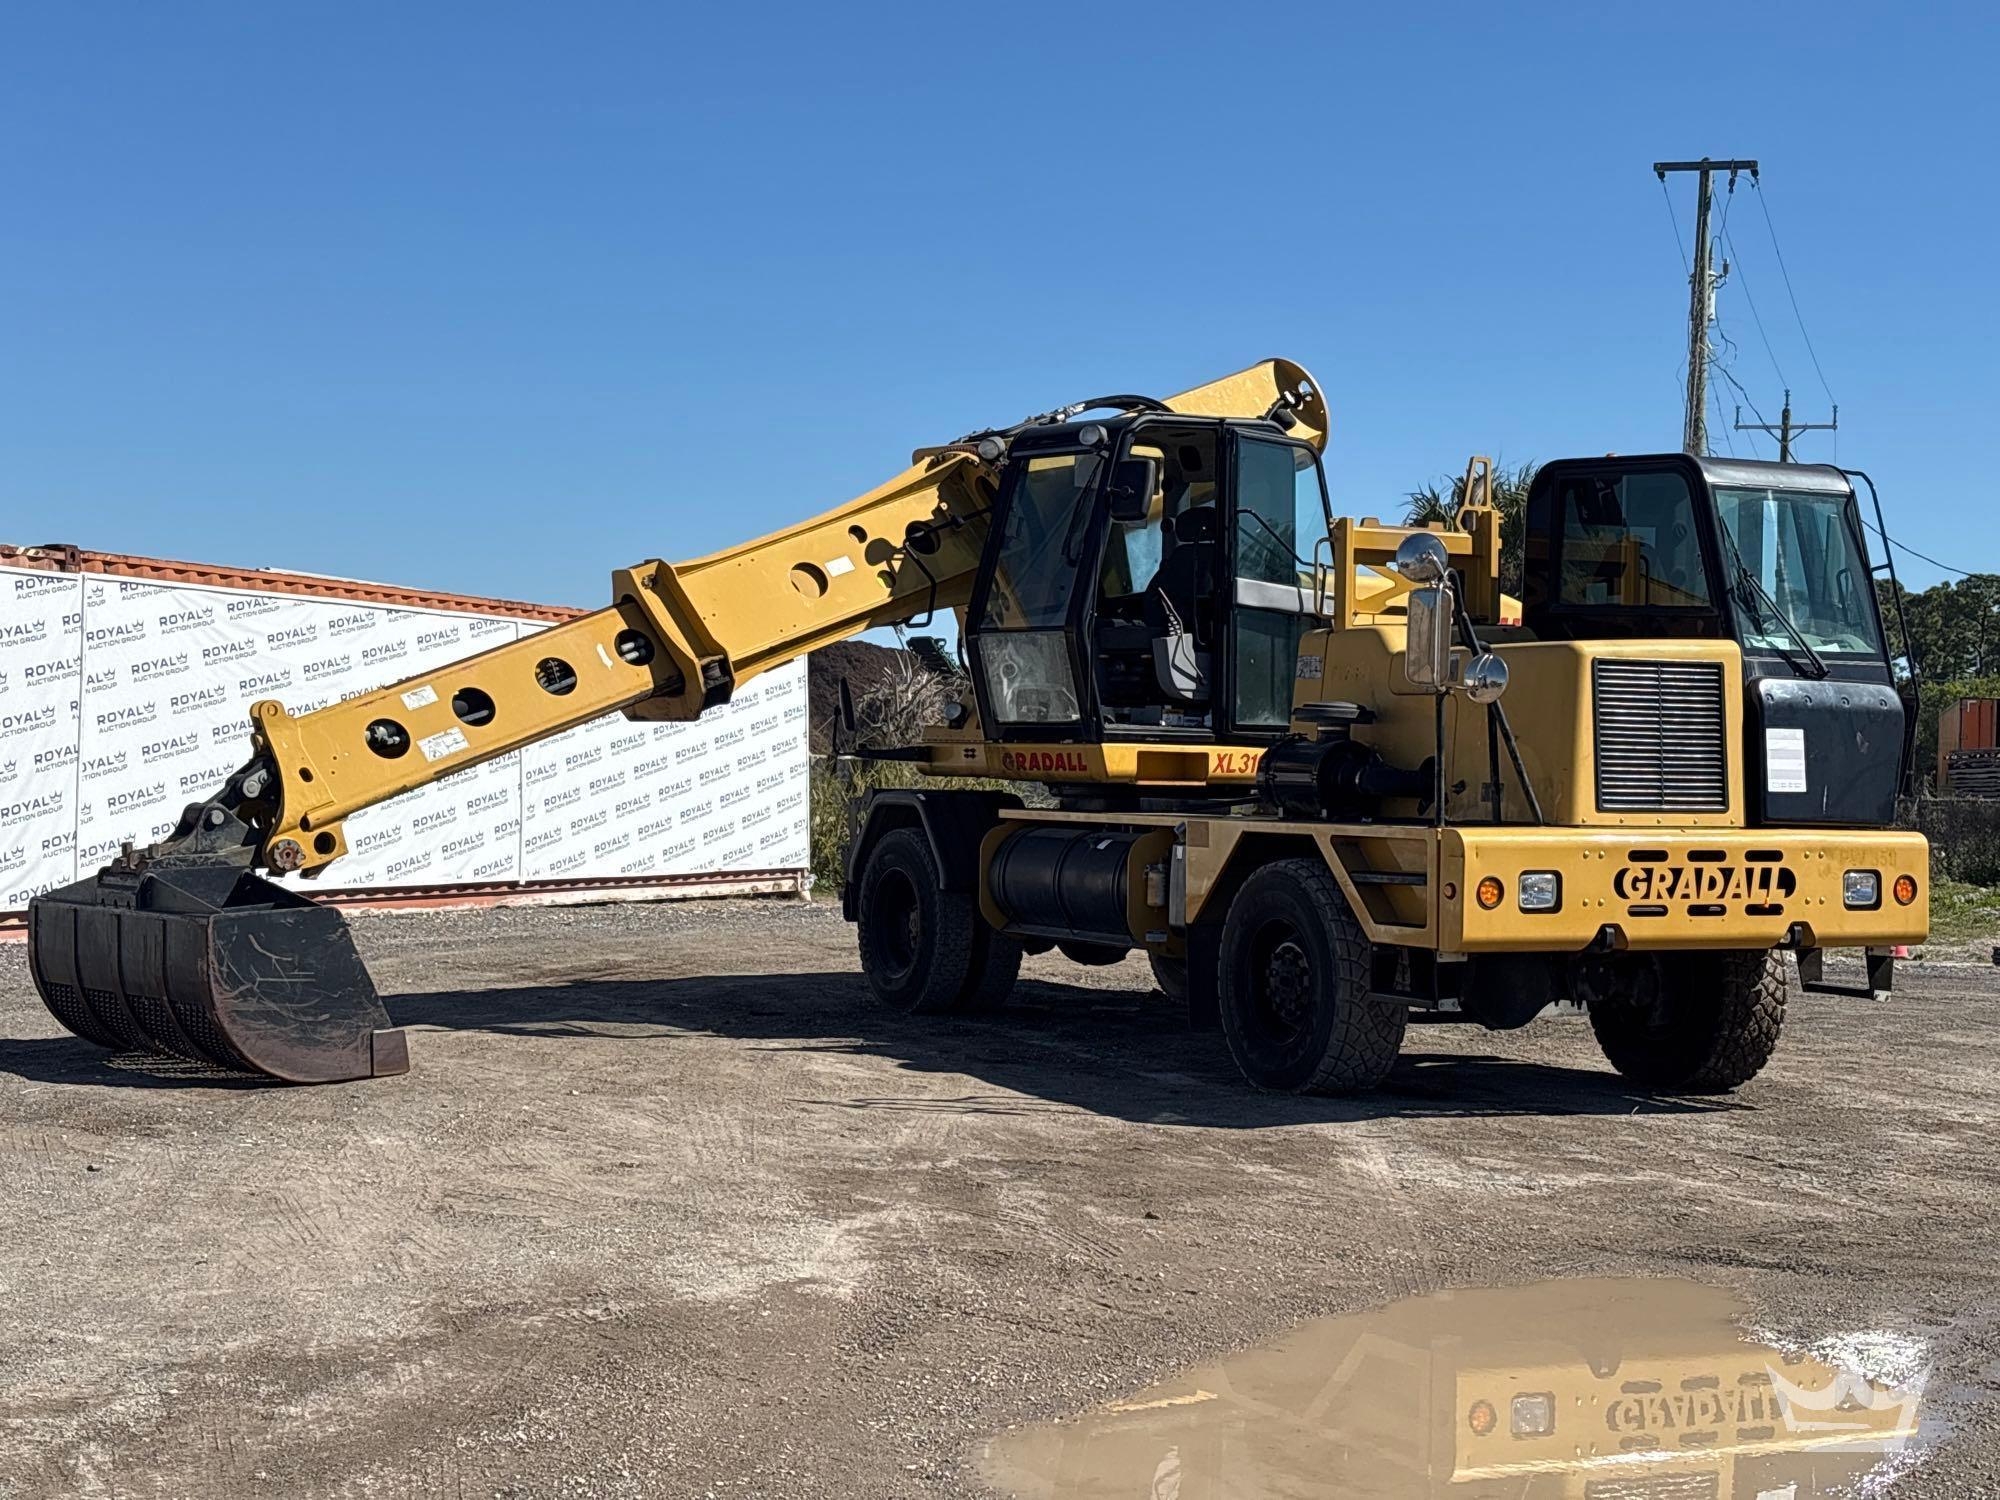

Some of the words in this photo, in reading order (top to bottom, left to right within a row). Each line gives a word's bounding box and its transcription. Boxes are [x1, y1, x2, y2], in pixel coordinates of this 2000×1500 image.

[17, 588, 50, 600] AUCTION
[52, 583, 78, 593] GROUP
[121, 590, 153, 601] AUCTION
[227, 596, 268, 613] ROYAL
[229, 611, 257, 620] AUCTION
[258, 606, 280, 614] GROUP
[159, 609, 203, 627] ROYAL
[161, 624, 191, 634] AUCTION
[192, 619, 215, 628] GROUP
[329, 613, 365, 629] ROYAL
[389, 614, 412, 622] AUCTION
[86, 623, 132, 642] ROYAL
[267, 627, 306, 644] ROYAL
[330, 627, 355, 636] AUCTION
[356, 622, 376, 631] GROUP
[417, 629, 450, 645] ROYAL
[20, 633, 47, 644] GROUP
[88, 639, 119, 650] AUCTION
[121, 633, 146, 643] GROUP
[269, 641, 295, 651] AUCTION
[297, 636, 318, 645] GROUP
[203, 641, 244, 659] ROYAL
[205, 656, 233, 666] AUCTION
[234, 650, 257, 659] GROUP
[362, 643, 397, 659] ROYAL
[363, 656, 387, 666] AUCTION
[388, 651, 407, 660] GROUP
[25, 657, 74, 679] ROYAL
[131, 656, 176, 675] ROYAL
[134, 671, 164, 682] AUCTION
[165, 666, 189, 675] GROUP
[303, 657, 341, 674] ROYAL
[305, 671, 330, 681] AUCTION
[332, 666, 352, 675] GROUP
[26, 674, 60, 687] AUCTION
[90, 683, 116, 693] GROUP
[240, 672, 280, 690] ROYAL
[242, 687, 269, 697] AUCTION
[270, 681, 292, 690] GROUP
[171, 688, 214, 707] ROYAL
[173, 703, 202, 715] AUCTION
[203, 697, 226, 707] GROUP
[730, 695, 753, 708] ROYAL
[97, 705, 143, 726] ROYAL
[287, 701, 318, 717] OYAL
[2, 710, 41, 728] OYAL
[99, 721, 130, 733] AUCTION
[132, 715, 157, 725] GROUP
[212, 718, 253, 737] ROYAL
[0, 726, 28, 739] UCTION
[29, 719, 56, 731] GROUP
[654, 722, 679, 735] ROYAL
[142, 736, 186, 756] ROYAL
[215, 733, 243, 745] AUCTION
[611, 734, 637, 750] ROYAL
[715, 730, 737, 745] ROYAL
[144, 752, 174, 764] AUCTION
[176, 745, 199, 755] GROUP
[566, 749, 594, 766] ROYAL
[676, 744, 700, 759] ROYAL
[737, 752, 760, 766] ROYAL
[35, 758, 68, 773] AUCTION
[101, 765, 126, 776] GROUP
[634, 758, 660, 774] ROYAL
[1001, 752, 1088, 772] GRADALL
[180, 766, 223, 787] ROYAL
[526, 768, 549, 780] OYAL
[590, 773, 617, 790] ROYAL
[700, 766, 723, 781] ROYAL
[182, 782, 211, 794] AUCTION
[659, 781, 684, 796] ROYAL
[720, 788, 743, 803] ROYAL
[107, 786, 153, 808] ROYAL
[110, 803, 140, 816] AUCTION
[142, 795, 166, 806] GROUP
[381, 798, 407, 810] AUCTION
[407, 791, 426, 802] GROUP
[468, 792, 499, 810] ROYAL
[544, 790, 573, 807] ROYAL
[616, 796, 642, 813] ROYAL
[0, 796, 50, 818] ROYAL
[2, 813, 36, 826] AUCTION
[38, 805, 64, 818] GROUP
[681, 803, 705, 819] ROYAL
[413, 810, 447, 829] ROYAL
[495, 819, 520, 835] ROYA
[571, 812, 599, 830] ROYAL
[638, 819, 664, 836] ROYAL
[356, 829, 391, 849] ROYAL
[525, 830, 554, 848] ROYAL
[704, 824, 727, 840] ROYAL
[80, 837, 123, 860] ROYAL
[358, 843, 382, 856] AUCTION
[383, 836, 402, 847] GROUP
[443, 835, 475, 854] ROYAL
[595, 836, 621, 853] ROYAL
[663, 840, 688, 857] ROYAL
[723, 845, 746, 861] ROYAL
[80, 854, 112, 869] AUCTION
[387, 855, 421, 875] ROYAL
[473, 858, 504, 877] ROYAL
[549, 853, 578, 872] ROYAL
[621, 856, 648, 873] ROYAL
[389, 869, 412, 881] AUCTION
[1621, 866, 1788, 900] GRADALL
